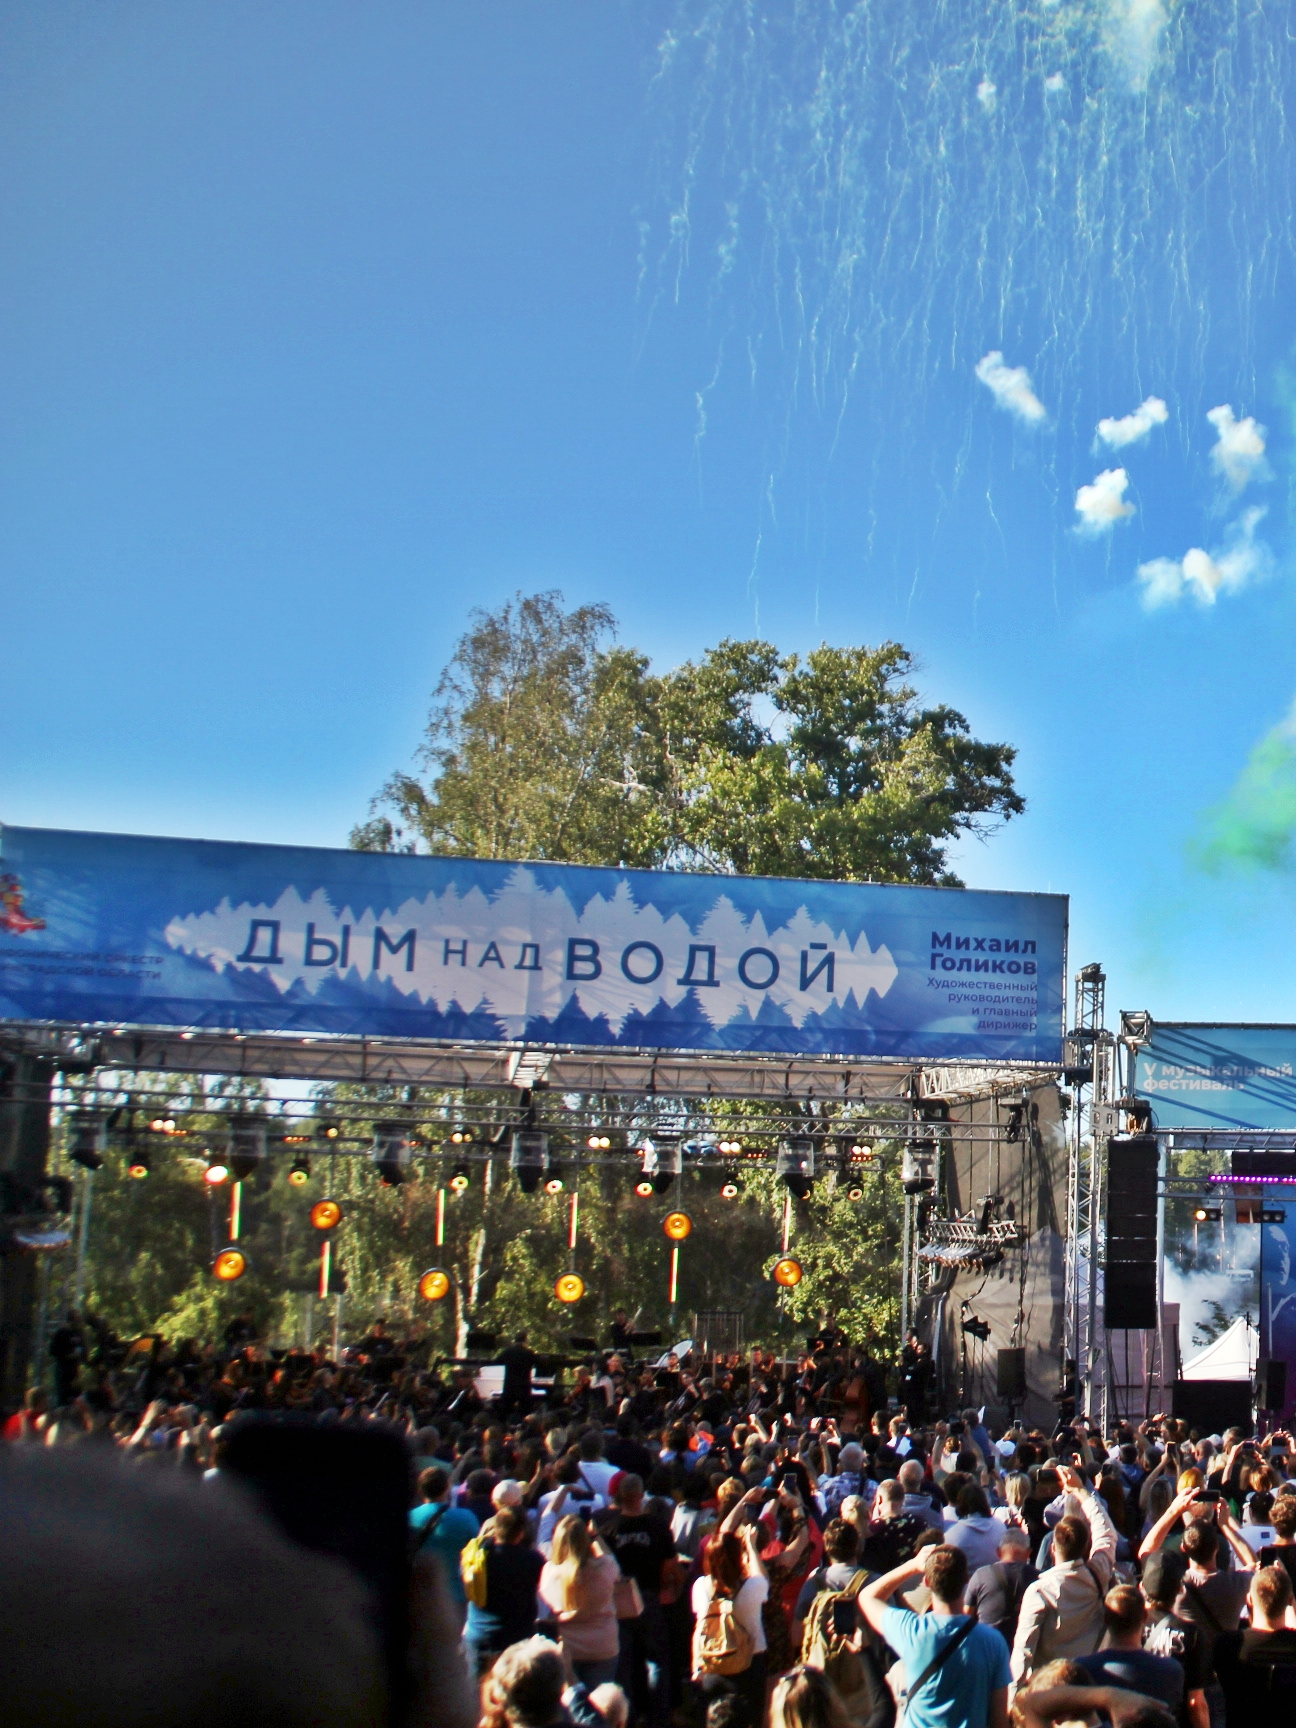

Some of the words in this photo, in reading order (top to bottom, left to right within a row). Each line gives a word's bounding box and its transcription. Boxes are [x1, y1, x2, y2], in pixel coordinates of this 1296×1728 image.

[931, 931, 1037, 954] Михаил
[236, 918, 417, 972] ДЫМ
[442, 938, 543, 970] НАД
[566, 936, 836, 992] ВОДОЙ
[930, 952, 1037, 975] Голиков
[926, 977, 1038, 991] Художественный
[948, 992, 1038, 1005] руководитель
[971, 1007, 980, 1015] и
[983, 1005, 1037, 1017] главный
[977, 1020, 1037, 1032] дирижер
[1143, 1063, 1157, 1076] V
[1162, 1063, 1293, 1079] музыкальный
[1143, 1076, 1244, 1093] фестиваль
